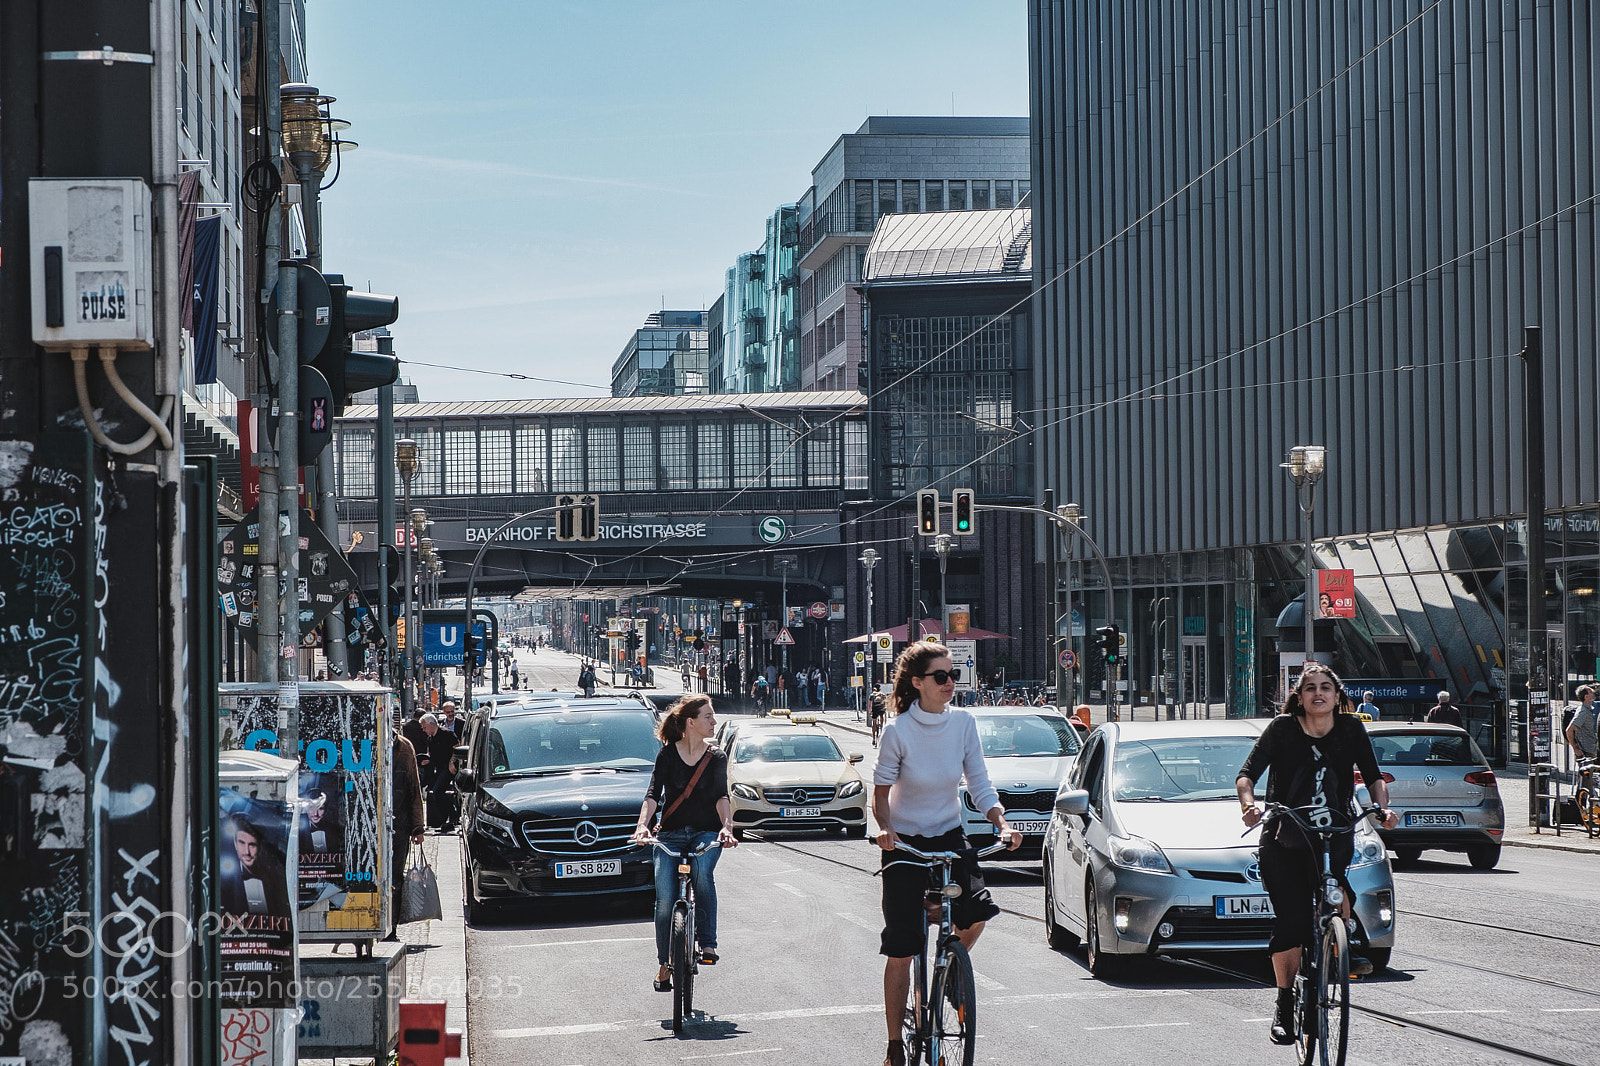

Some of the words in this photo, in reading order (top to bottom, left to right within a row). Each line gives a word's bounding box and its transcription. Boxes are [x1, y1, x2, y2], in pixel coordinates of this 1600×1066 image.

[82, 296, 125, 320] PULSE
[466, 527, 543, 542] BAHNHOF
[548, 523, 707, 540] FRICHSTRASSE
[763, 518, 781, 542] S
[316, 593, 333, 603] POSER
[440, 627, 457, 647] U
[786, 808, 791, 816] B
[796, 808, 804, 816] HF
[806, 808, 819, 816] 534
[1412, 815, 1418, 824] B
[1423, 815, 1434, 824] SB
[1436, 815, 1457, 824] 5519
[1012, 822, 1025, 832] AD
[1026, 822, 1049, 832] 5997
[566, 864, 573, 875] B
[580, 863, 594, 874] SB
[596, 862, 616, 873] 829
[1230, 898, 1250, 913] LN
[1260, 898, 1270, 913] A
[234, 960, 273, 972] eventim.de
